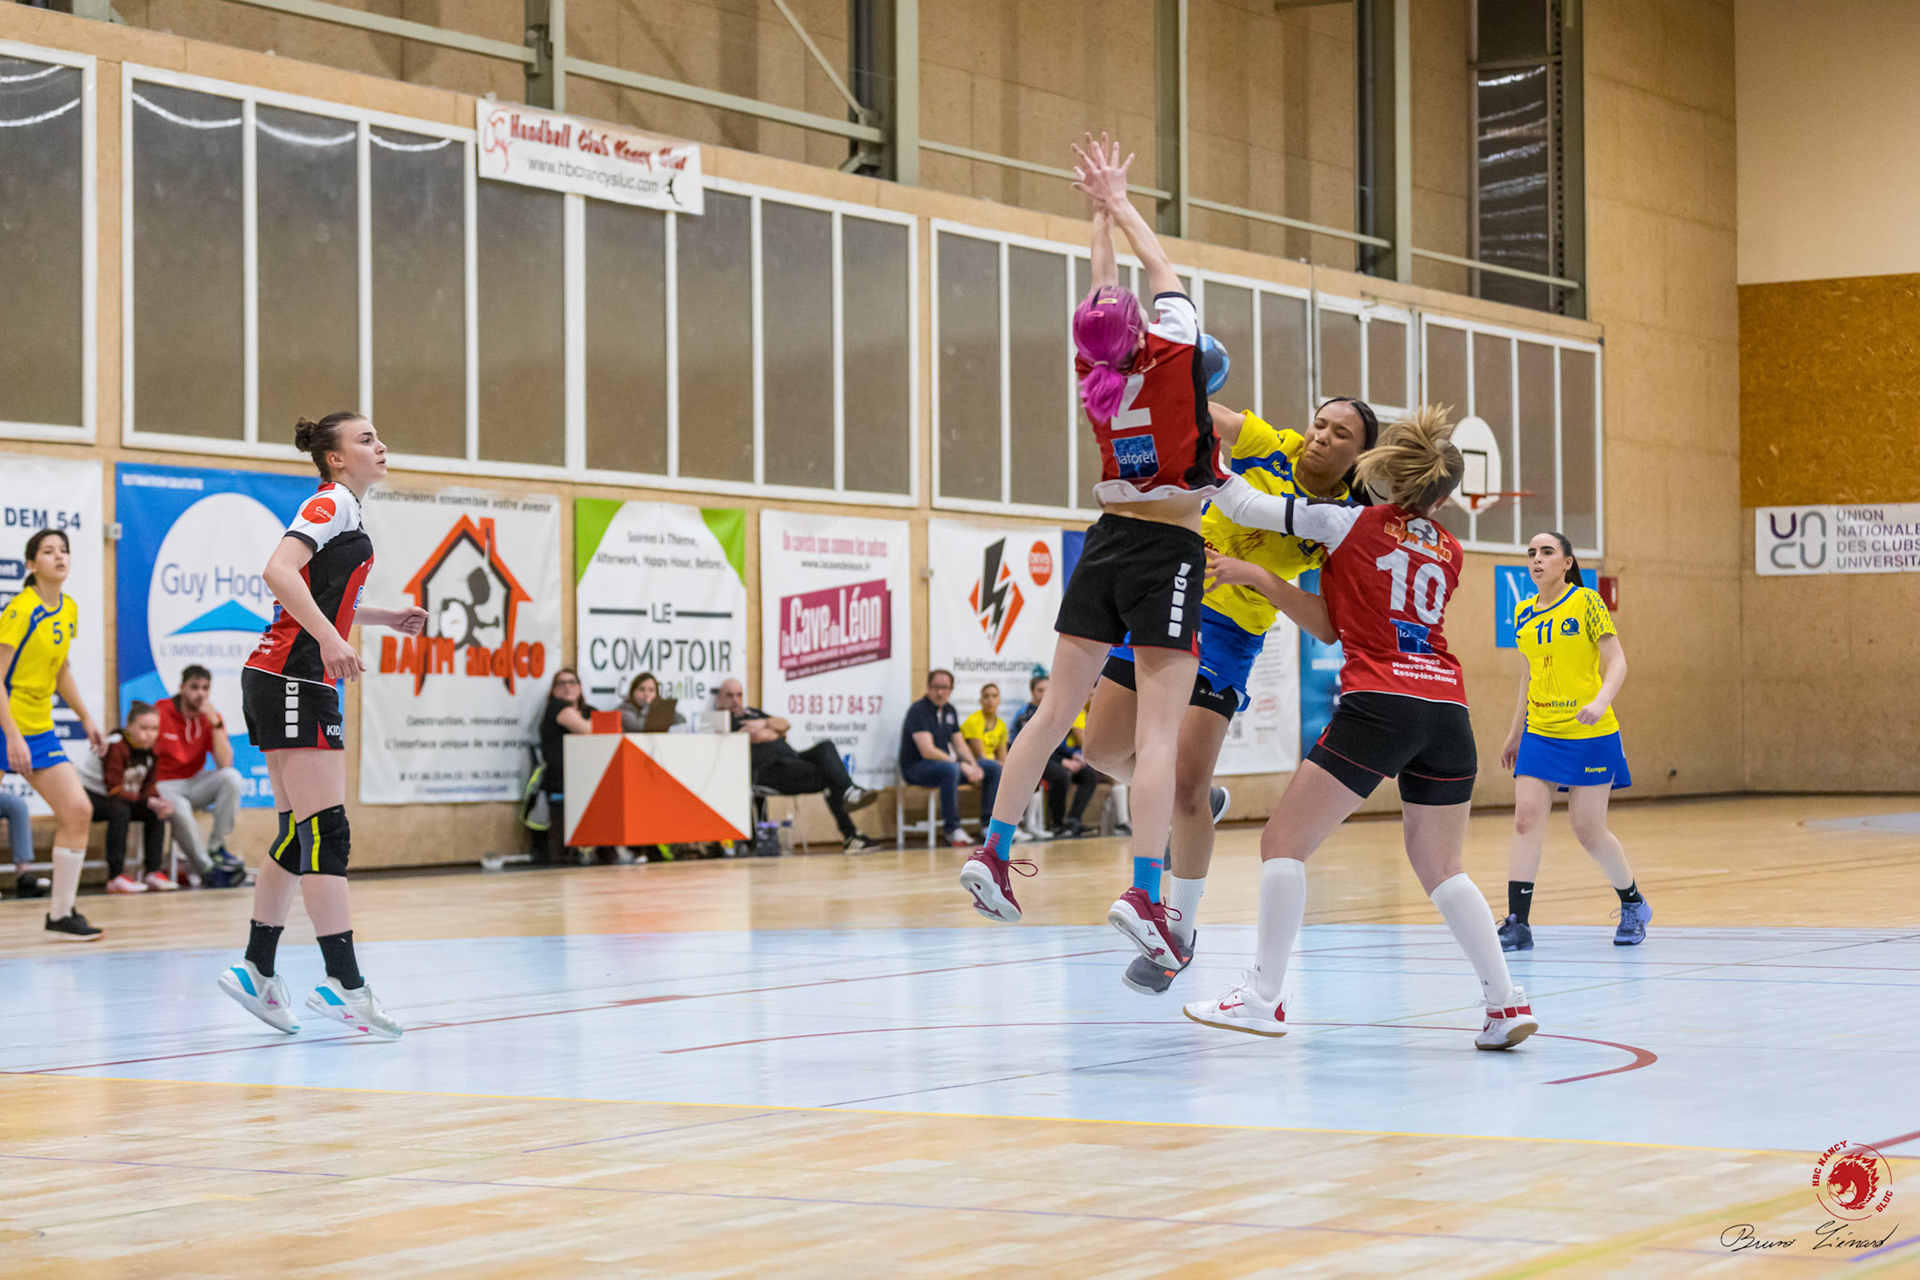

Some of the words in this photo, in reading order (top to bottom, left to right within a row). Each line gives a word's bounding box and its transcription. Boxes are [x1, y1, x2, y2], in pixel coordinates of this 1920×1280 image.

[511, 114, 571, 148] Handball
[578, 129, 609, 157] Club
[1111, 373, 1152, 431] 2
[5, 507, 48, 529] DEM
[57, 512, 80, 530] 54
[1836, 509, 1884, 522] UNION
[1836, 540, 1867, 553] DES
[161, 562, 208, 603] Guy
[214, 565, 276, 604] Hoqu
[1376, 548, 1447, 625] 10
[652, 602, 672, 624] LE
[790, 596, 830, 655] Cave
[839, 585, 882, 645] Léon
[53, 622, 63, 645] 5
[1535, 618, 1553, 644] 11
[590, 637, 731, 672] COMPTOIR
[953, 657, 1037, 673] HelloHomeLorrain
[788, 694, 804, 715] 03
[808, 694, 823, 715] 83
[829, 694, 844, 715] 17
[848, 694, 863, 715] 84
[868, 694, 883, 715] 57
